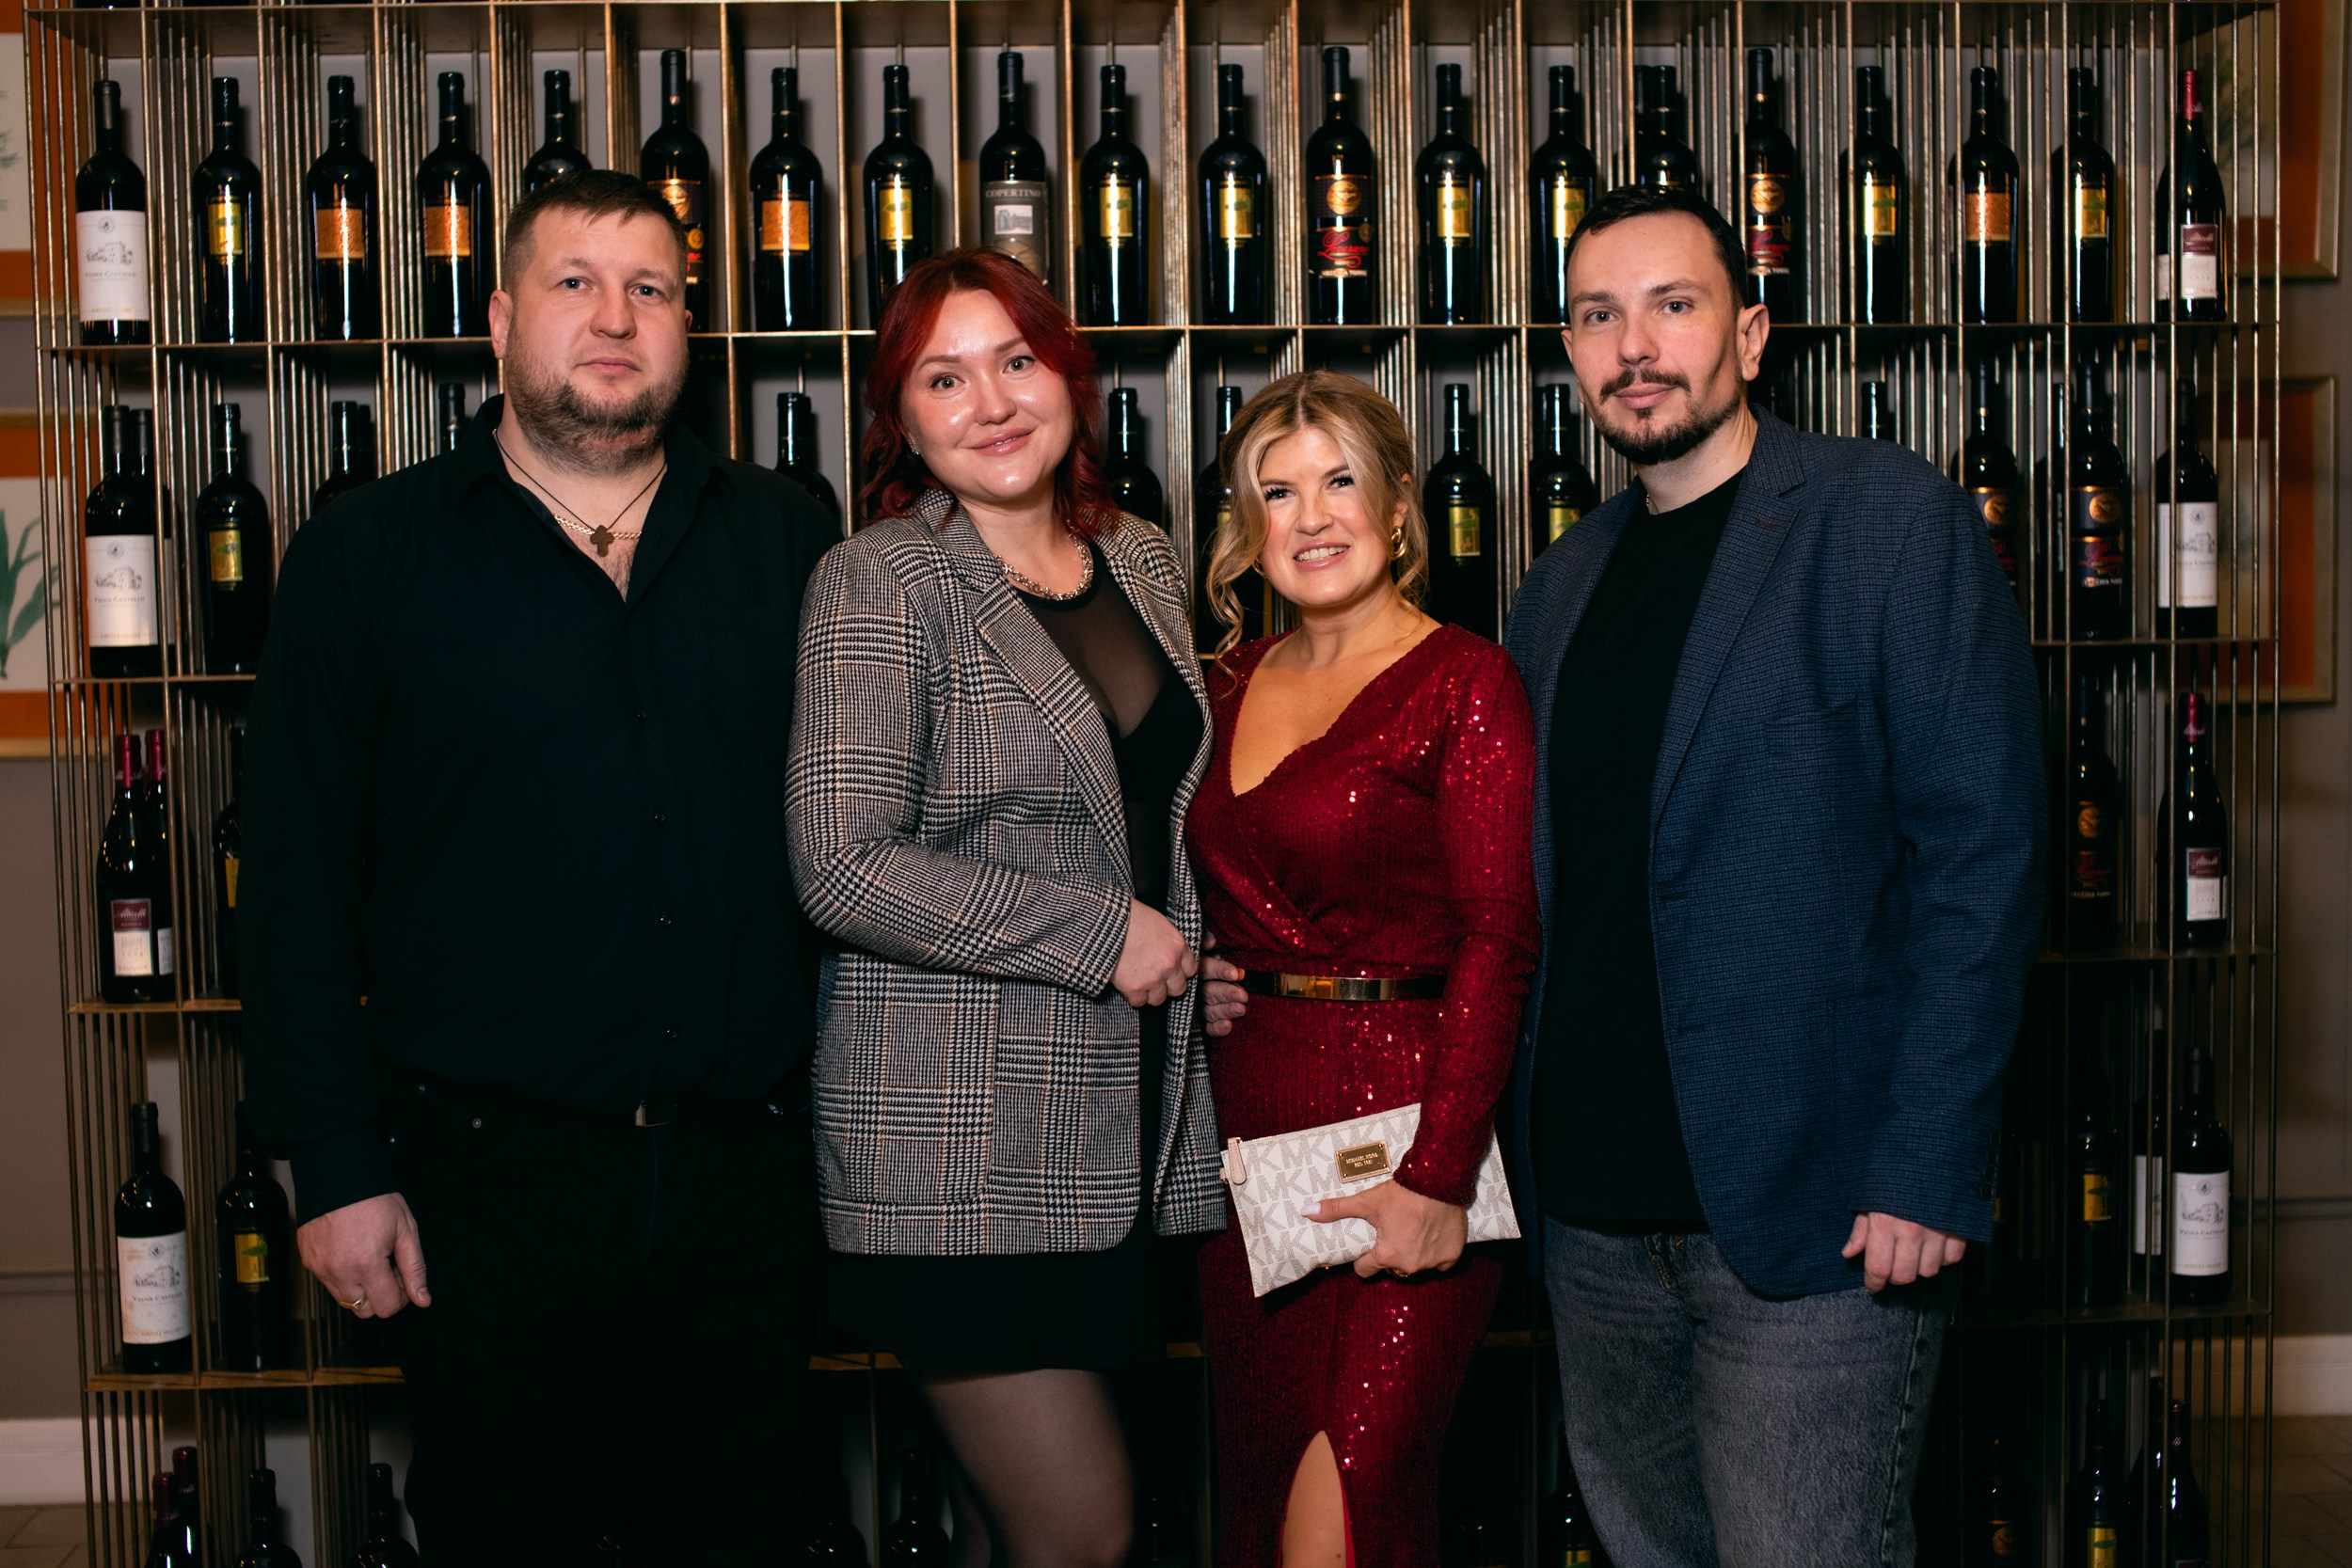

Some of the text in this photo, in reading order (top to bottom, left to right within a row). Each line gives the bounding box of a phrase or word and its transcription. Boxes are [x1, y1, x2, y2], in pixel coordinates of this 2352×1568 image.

[985, 188, 1041, 198] COPERTINO
[1256, 1168, 1311, 1204] MK
[1263, 1226, 1316, 1264] MK
